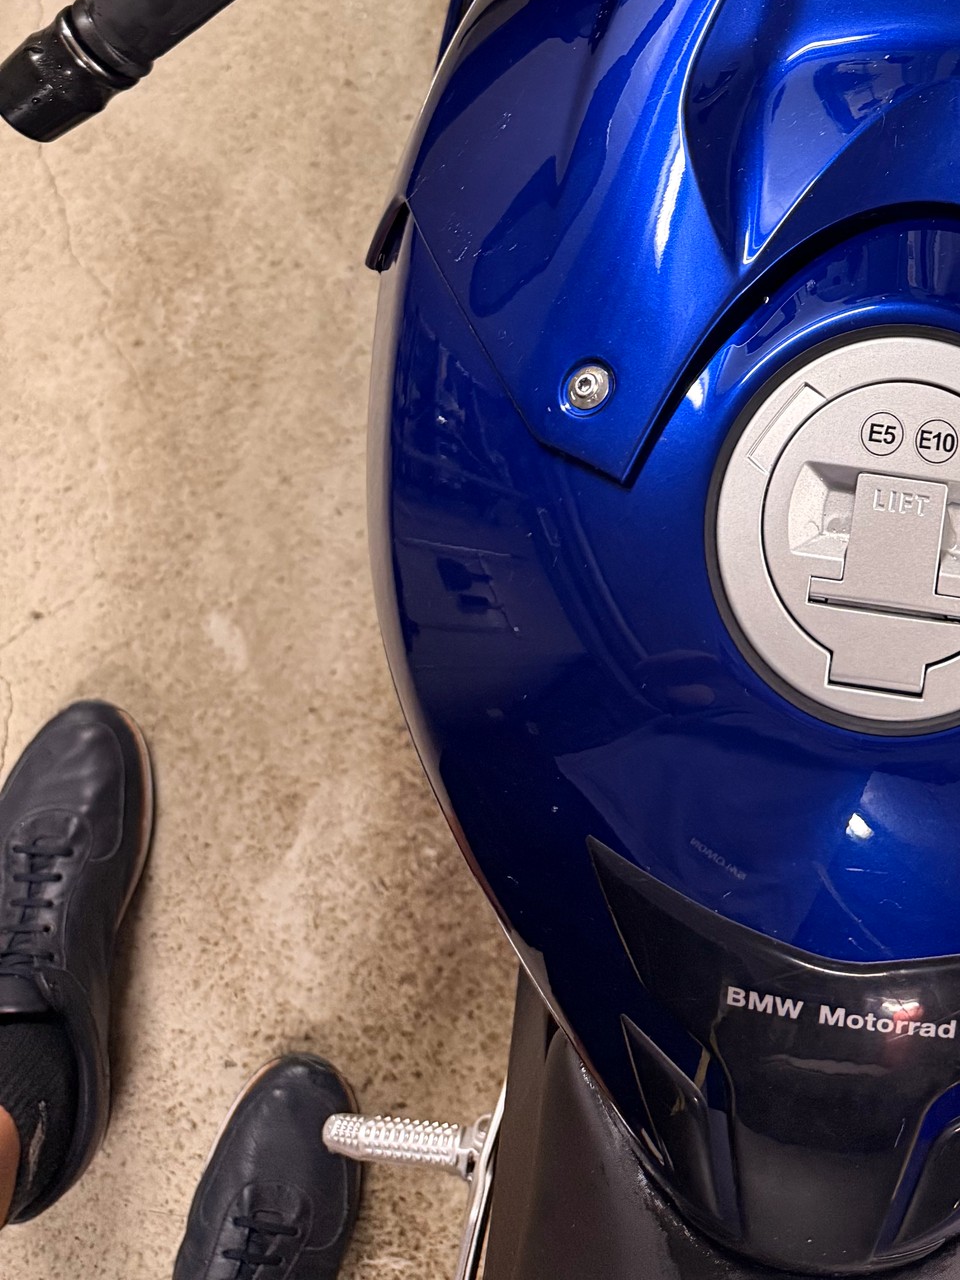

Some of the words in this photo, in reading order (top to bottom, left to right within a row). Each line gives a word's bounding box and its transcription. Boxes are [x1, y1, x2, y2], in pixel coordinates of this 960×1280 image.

[867, 422, 897, 446] E5
[918, 429, 956, 453] E10
[872, 487, 931, 518] LIFT
[726, 985, 804, 1020] BMW
[818, 1005, 957, 1039] Motorrad
